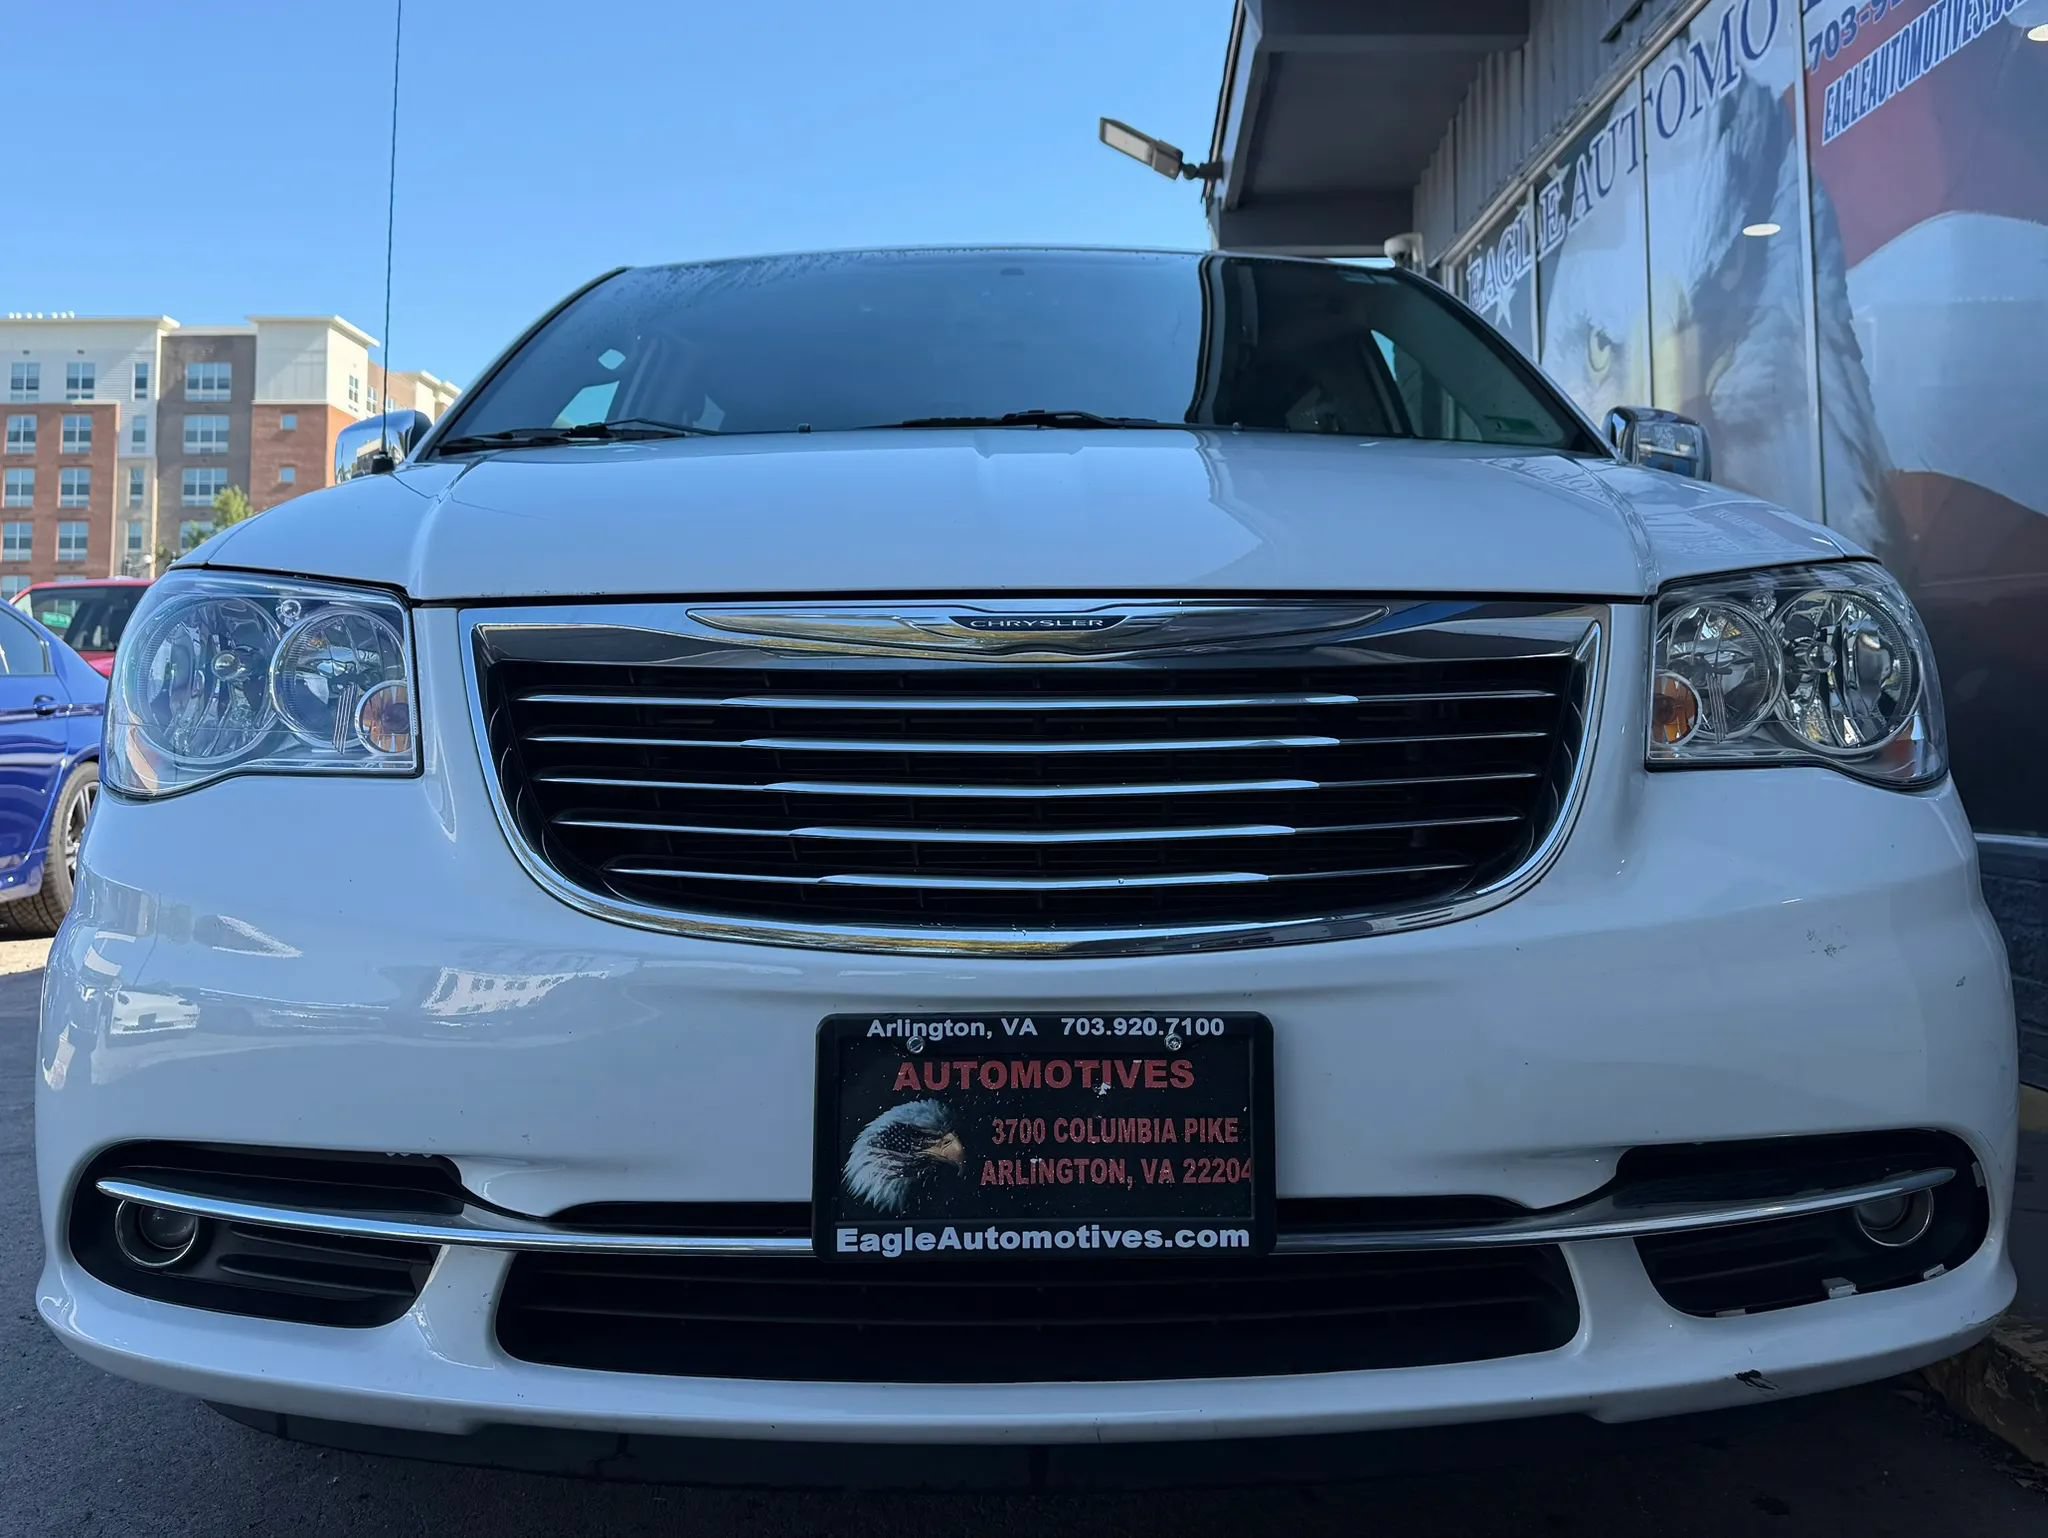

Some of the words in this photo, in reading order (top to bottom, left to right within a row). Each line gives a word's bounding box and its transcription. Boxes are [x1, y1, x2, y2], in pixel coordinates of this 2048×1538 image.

[1465, 175, 1571, 315] EAGLE
[1566, 0, 1821, 229] AUTOMO
[969, 619, 1104, 628] CHRYSLER
[866, 1018, 993, 1042] Arlington,
[1000, 1017, 1039, 1037] VA
[1060, 1017, 1226, 1037] 703.920.7100
[892, 1058, 1196, 1092] AUTOMOTIVES
[990, 1117, 1047, 1145] 3700
[1053, 1117, 1178, 1145] COLUMBIA
[1183, 1117, 1239, 1144] PIKE
[979, 1157, 1134, 1191] ARLINGTON,
[1140, 1157, 1176, 1185] VA
[1182, 1157, 1252, 1185] 22204
[835, 1224, 1251, 1258] EagleAutomotives.com
